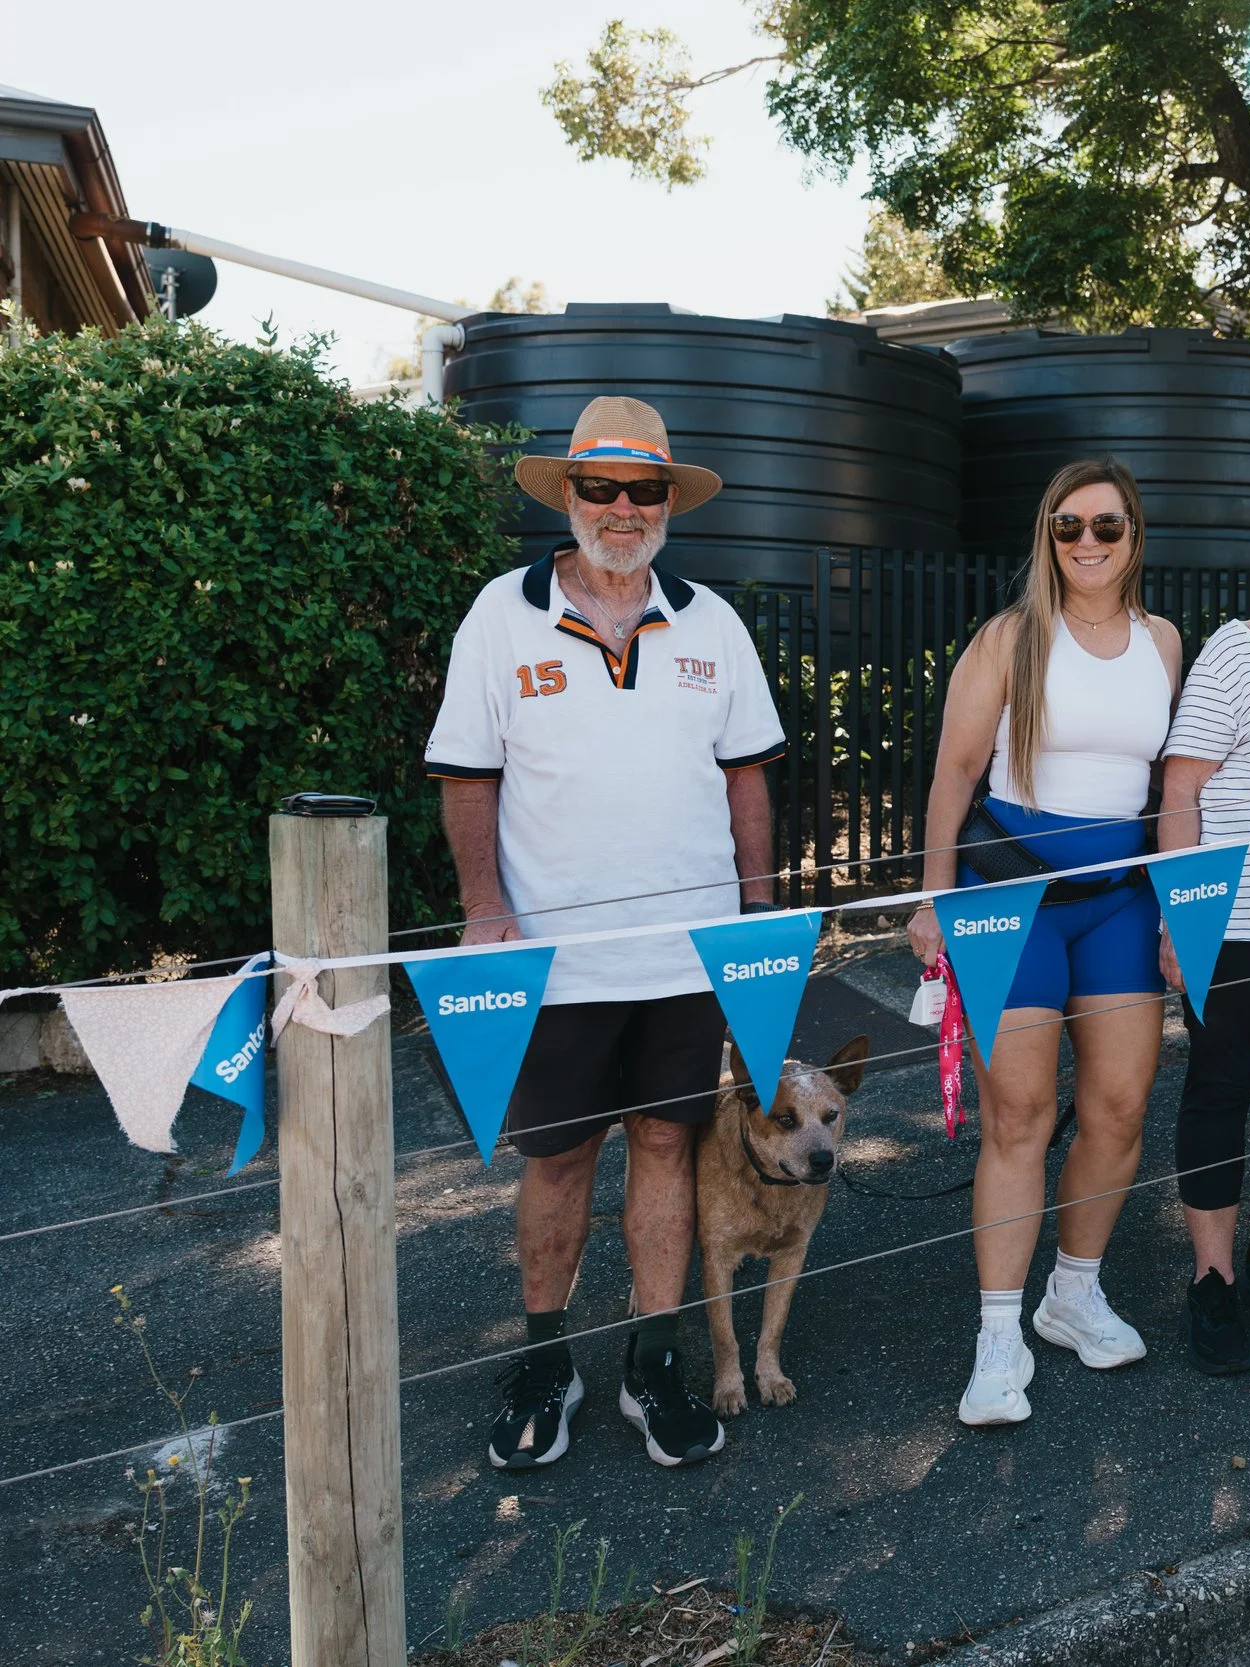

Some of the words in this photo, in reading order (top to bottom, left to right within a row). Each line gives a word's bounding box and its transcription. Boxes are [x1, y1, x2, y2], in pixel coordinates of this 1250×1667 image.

[516, 660, 567, 698] 15
[674, 657, 716, 680] TDU
[1169, 881, 1228, 906] Santos
[953, 915, 1021, 937] Santos
[722, 955, 800, 983] Santos
[438, 990, 528, 1016] Santos
